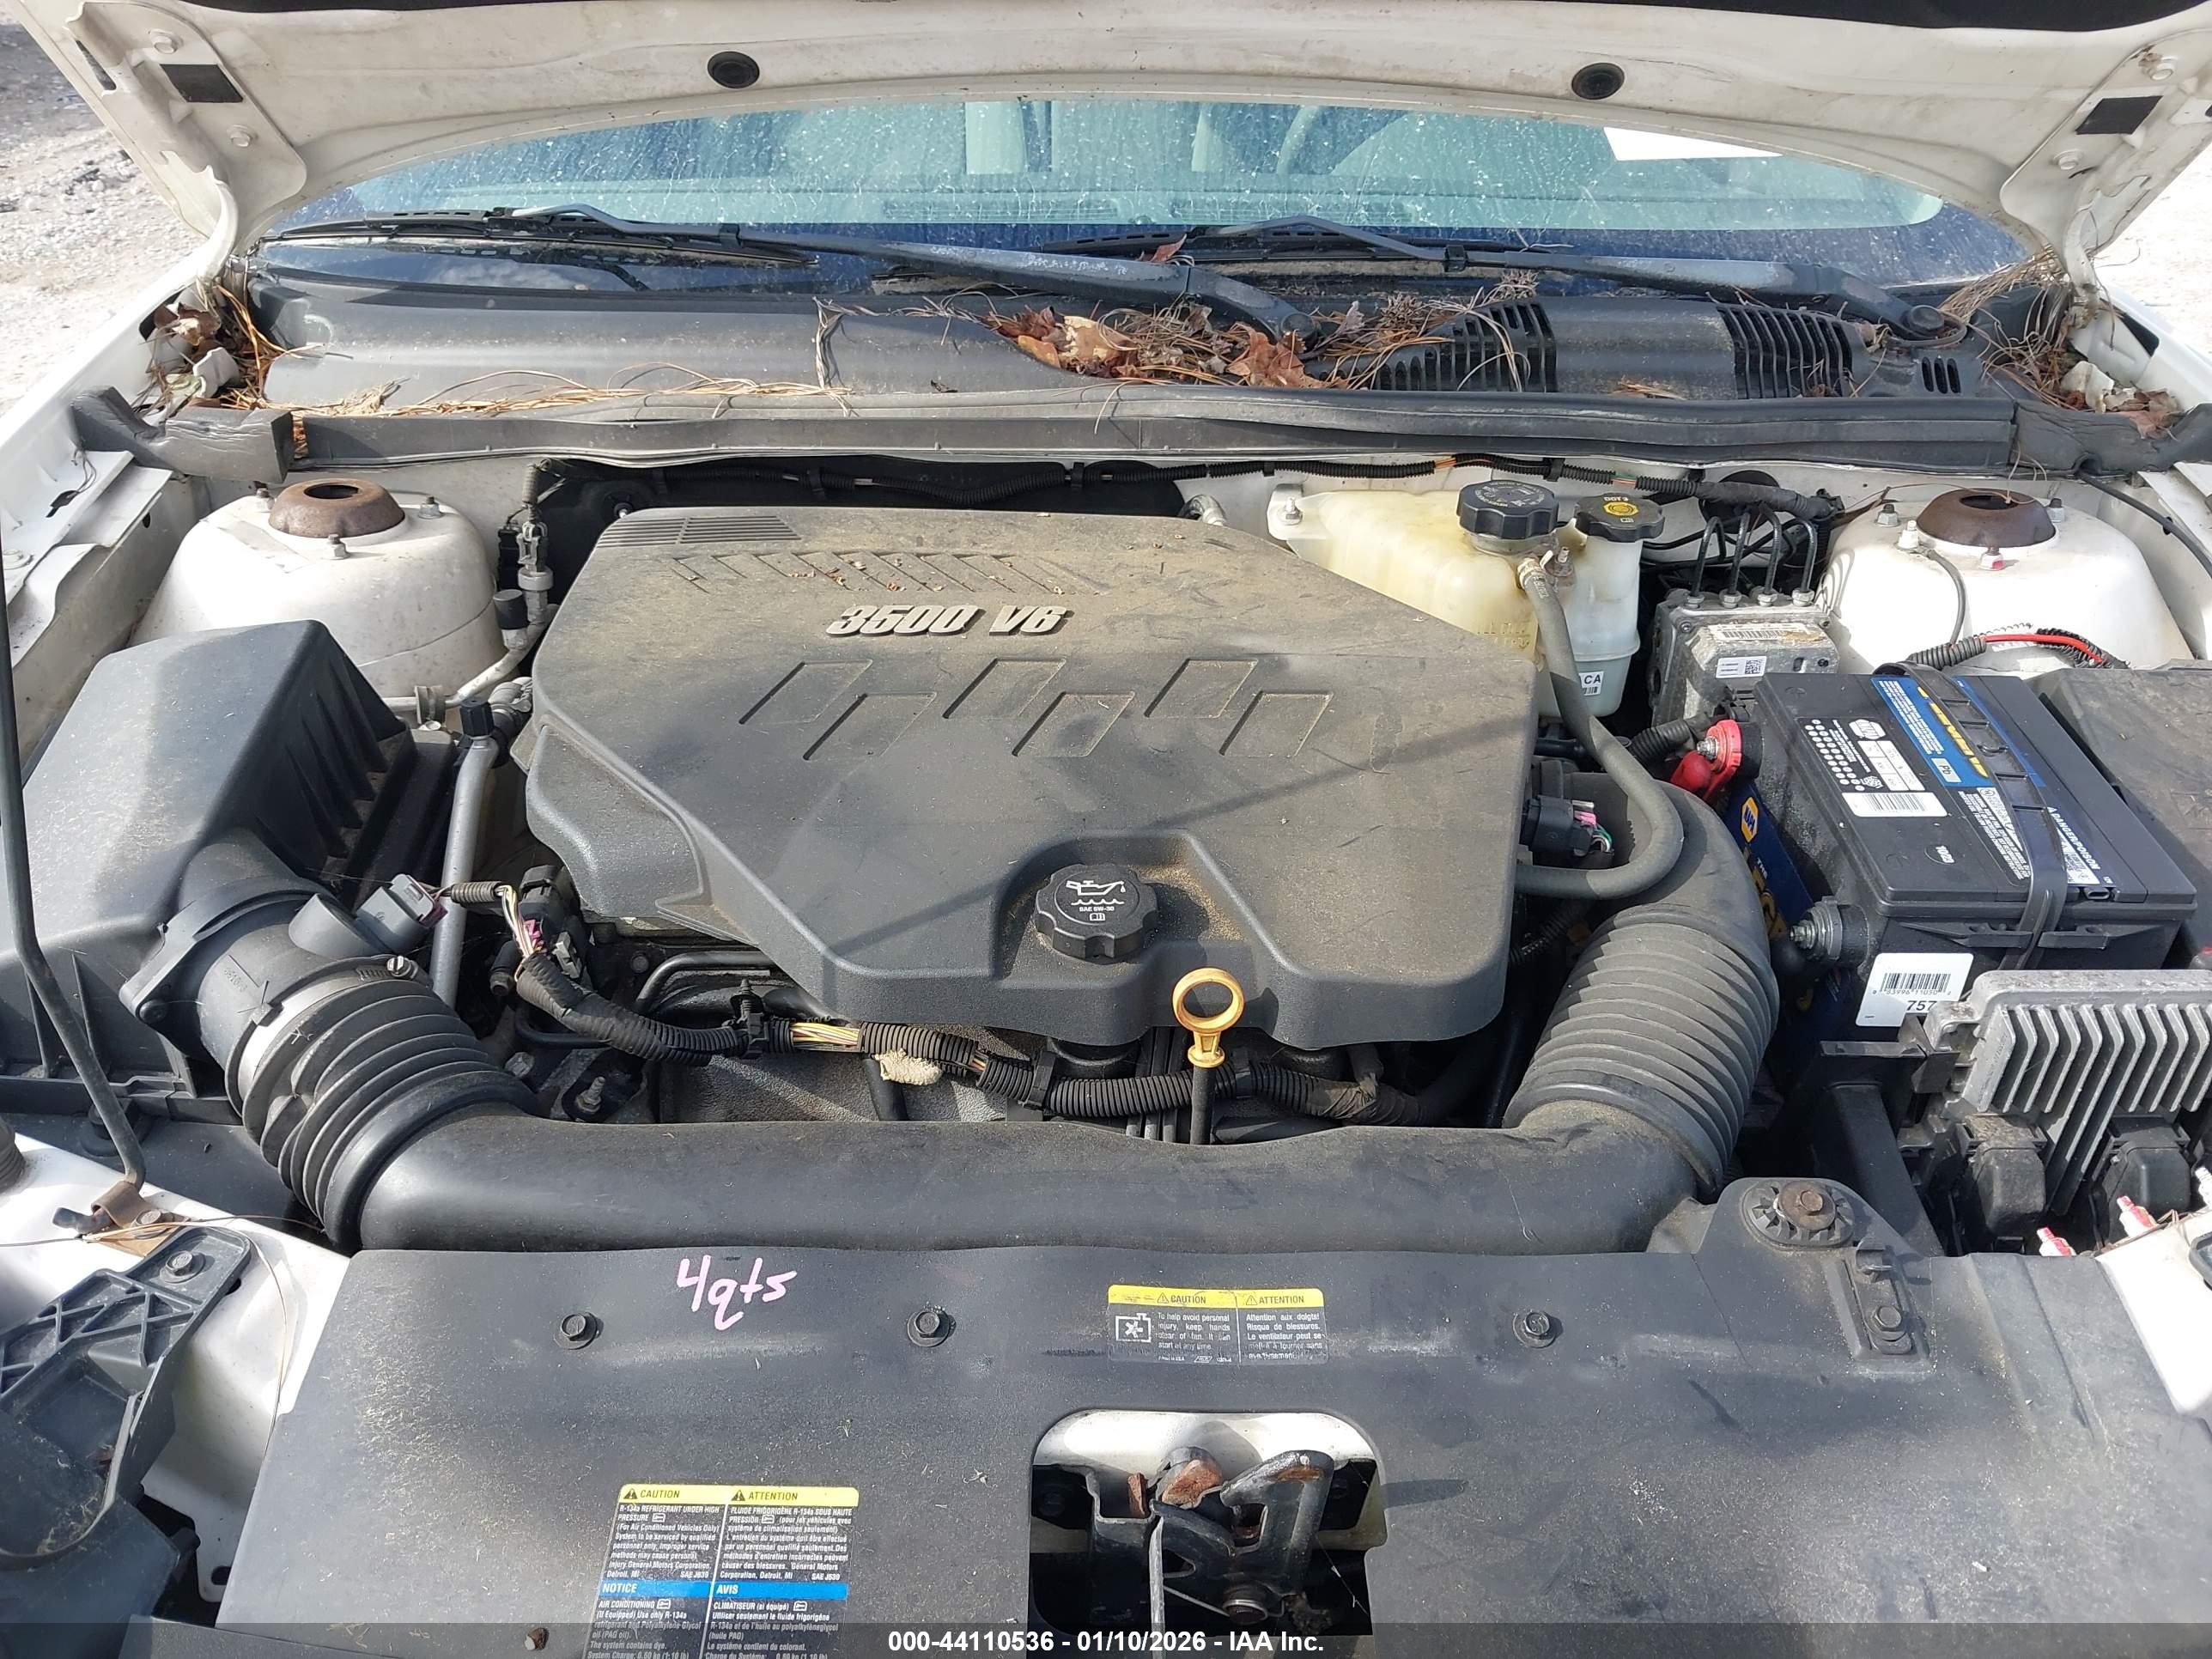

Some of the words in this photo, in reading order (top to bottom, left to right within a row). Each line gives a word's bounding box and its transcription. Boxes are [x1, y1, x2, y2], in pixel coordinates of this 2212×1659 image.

[826, 605, 980, 637] 3500
[988, 605, 1067, 637] V6
[1906, 1000, 1937, 1011] 757
[1170, 1295, 1206, 1304] CAUTION
[1259, 1296, 1304, 1304] ATTENTION
[1167, 1313, 1181, 1322] help
[1201, 1314, 1230, 1322] personal
[1297, 1312, 1320, 1322] doigts!
[1246, 1323, 1270, 1332] Risque
[1296, 1333, 1310, 1341] peut
[640, 1489, 680, 1498] CAUTION
[748, 1491, 799, 1501] ATTENTION
[641, 1523, 677, 1532] Conditioned
[615, 1533, 636, 1542] System
[680, 1534, 688, 1542] by
[689, 1534, 716, 1542] qualified
[611, 1551, 637, 1559] methods
[670, 1552, 697, 1560] personal
[602, 1583, 638, 1594] NOTICE
[716, 1584, 739, 1595] AVIS
[598, 1600, 611, 1608] AIR
[611, 1600, 655, 1609] CONDITIONING
[713, 1601, 756, 1611] CLIMATISEUR
[756, 1602, 766, 1611] (si
[650, 1611, 664, 1620] only
[626, 1641, 653, 1650] contains
